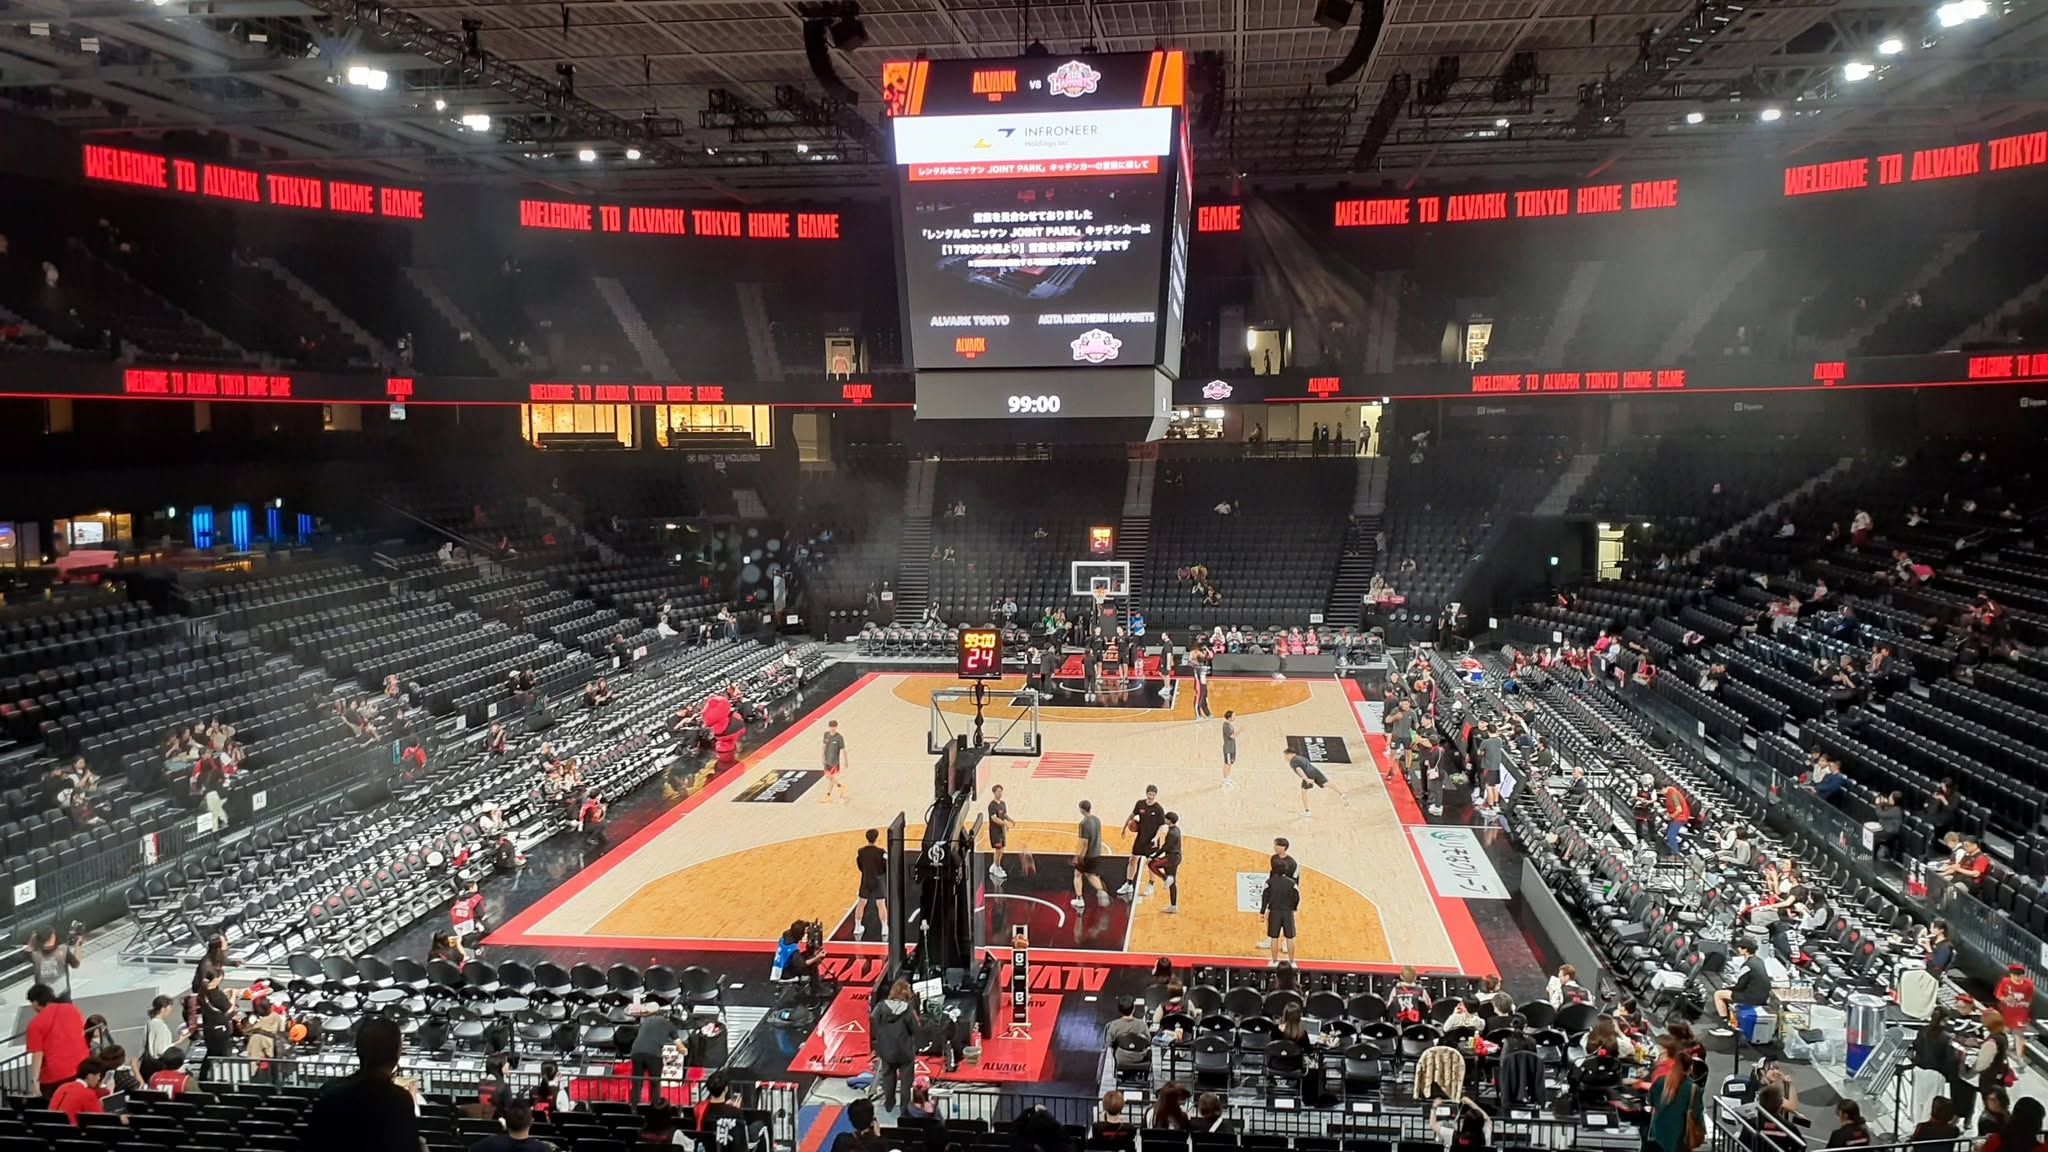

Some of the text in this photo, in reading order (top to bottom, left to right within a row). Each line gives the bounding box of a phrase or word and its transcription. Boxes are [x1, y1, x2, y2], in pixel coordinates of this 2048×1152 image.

[973, 70, 1017, 93] ALVARK
[1024, 124, 1098, 137] INFRONEER
[1024, 140, 1056, 149] Holdings
[987, 164, 1016, 175] JOINT
[1784, 131, 2048, 196] WELCOME TO ALVARK TOKYO
[85, 145, 423, 218] WELCOME TO ALVARK TOKYO HOME GAME
[1335, 179, 1678, 226] WELCOME TO ALVARK TOKYO HOME GAME
[520, 200, 839, 238] WELCOME TO ALVARK TOKYO HOME GAME
[1199, 206, 1240, 231] GAME
[1009, 226, 1044, 238] JOINT
[930, 315, 1010, 327] ALVARK TOKYO
[956, 338, 985, 353] ALVARK
[1308, 377, 1341, 393] ALVARK
[1472, 370, 1686, 393] WELCOME TO ALVARK TOKYO HOME GAME
[530, 384, 724, 402] WELCOME TO ALVARK TOKYO HOME GAME
[842, 384, 873, 399] ALVARK
[1008, 395, 1061, 414] 99:00
[1094, 537, 1110, 548] 24
[967, 648, 993, 668] 24
[982, 1062, 1027, 1072] ALVARK
